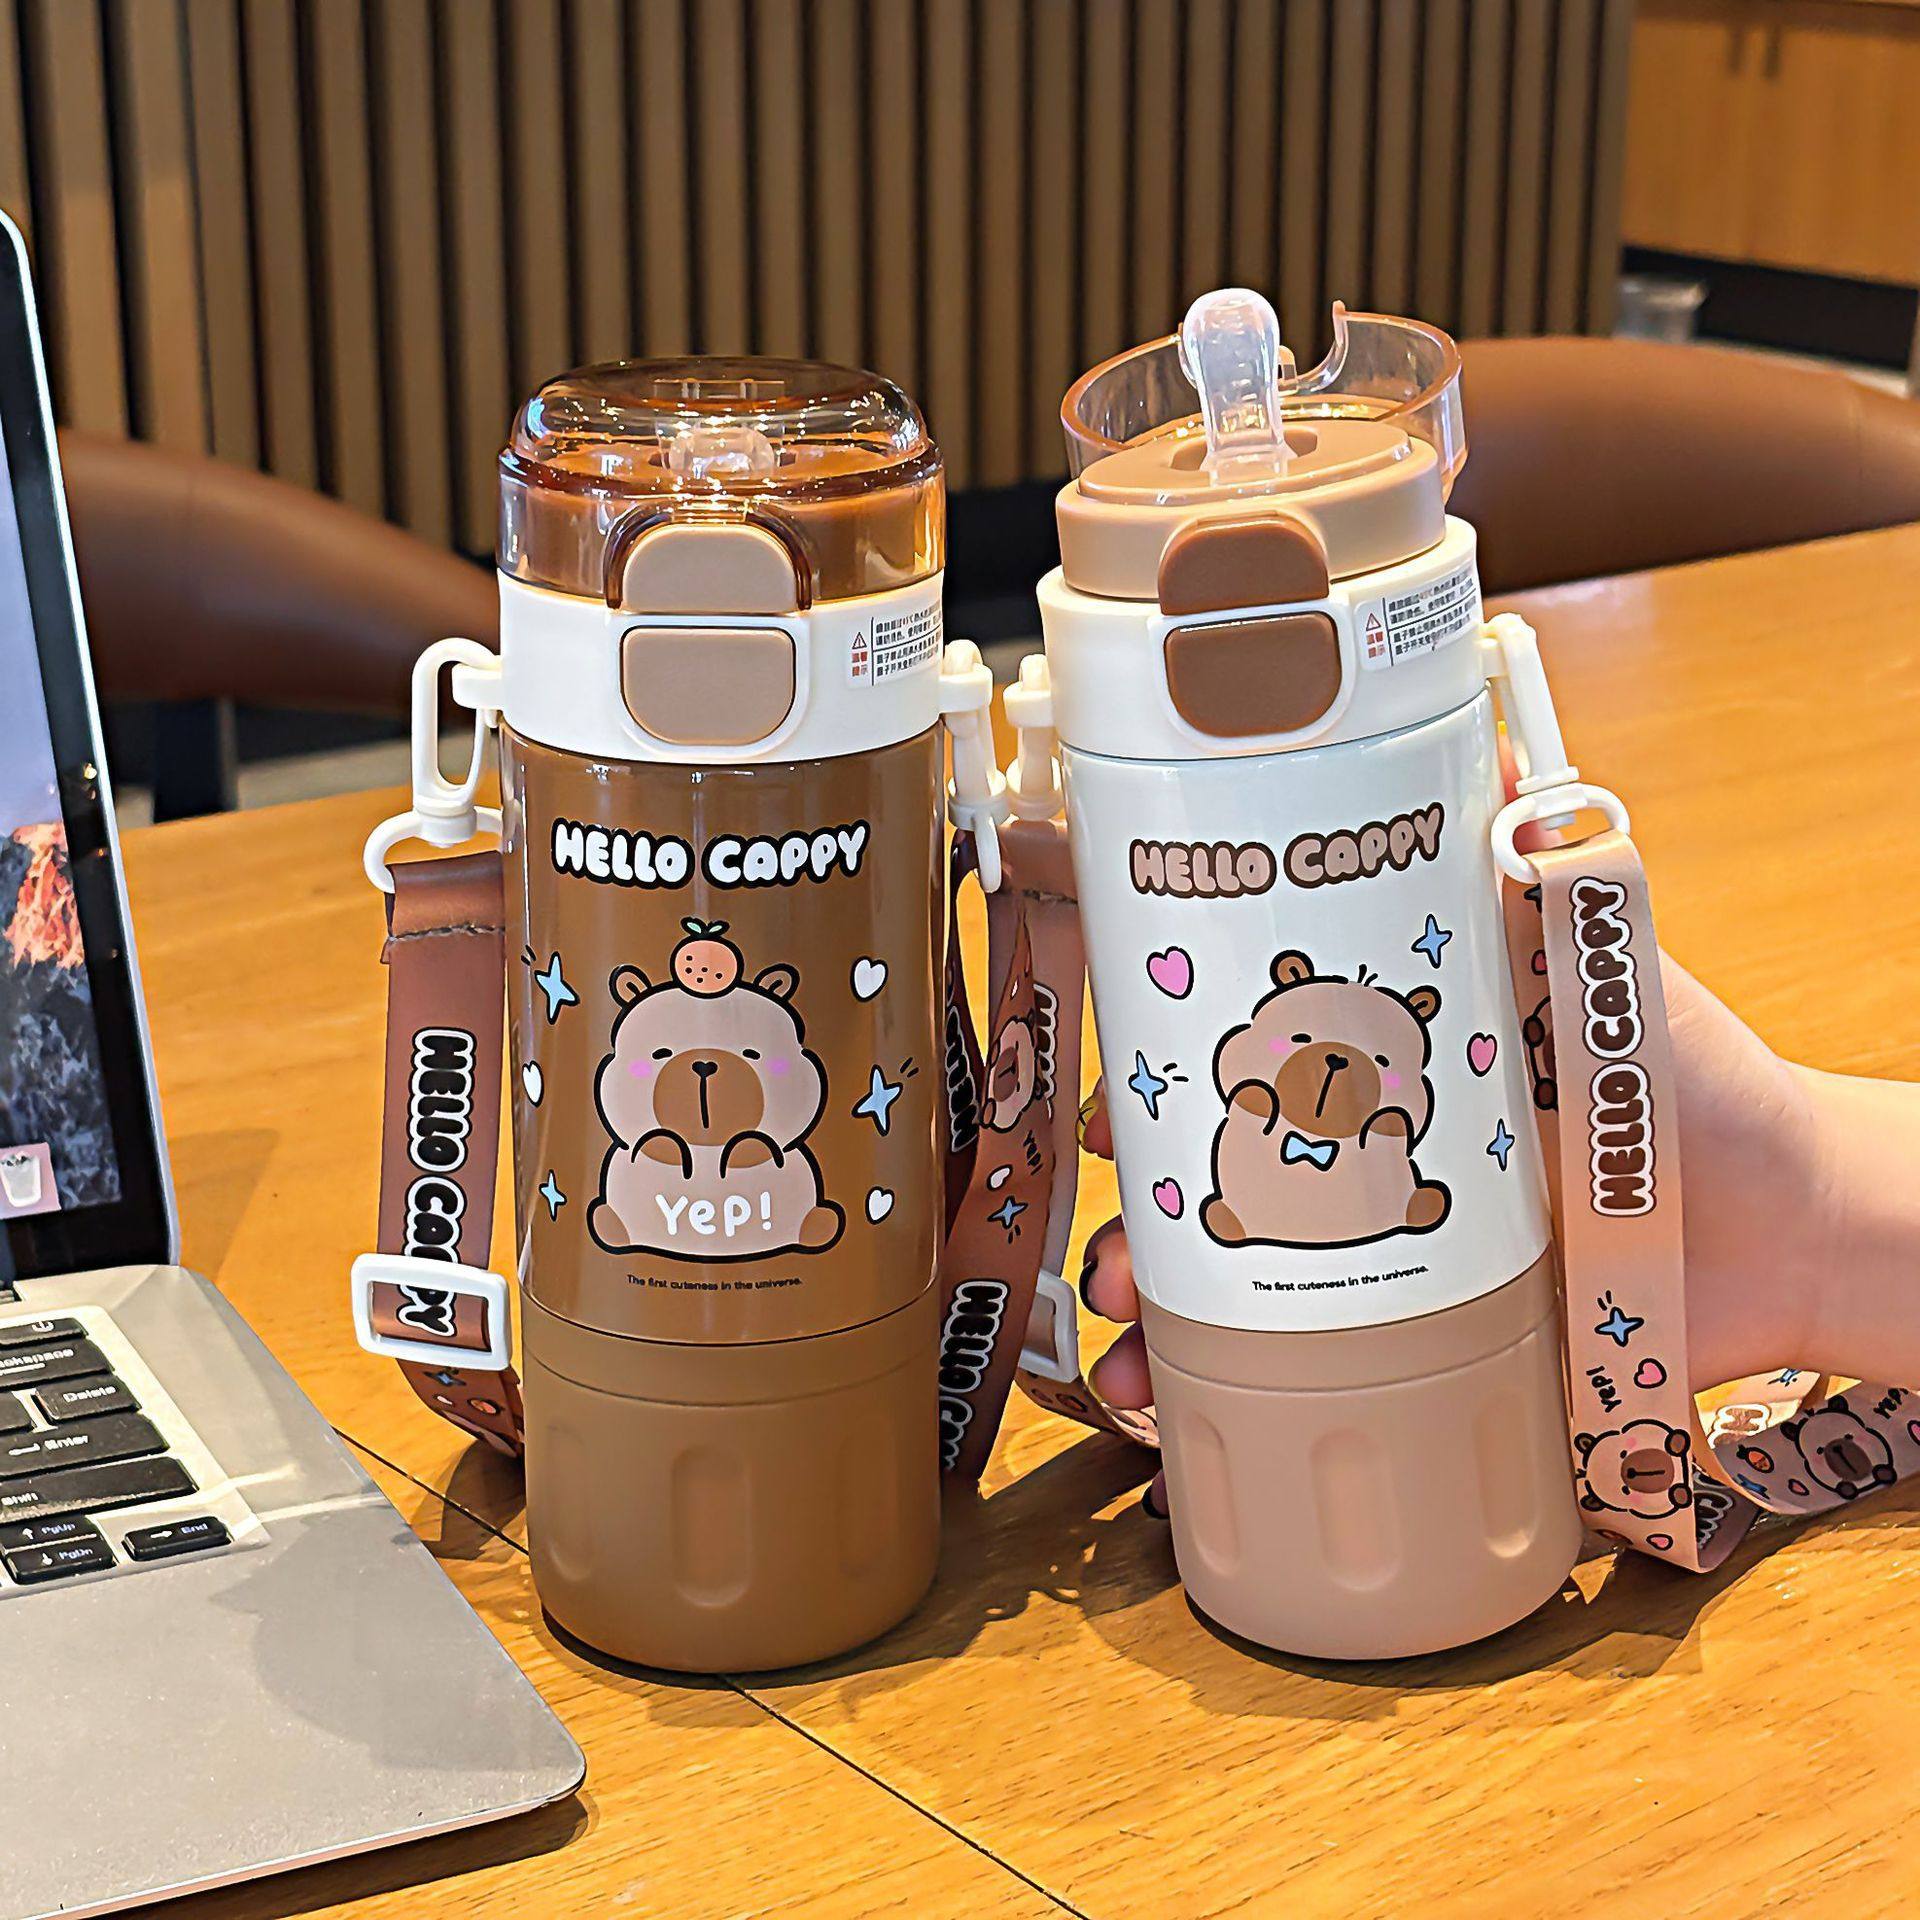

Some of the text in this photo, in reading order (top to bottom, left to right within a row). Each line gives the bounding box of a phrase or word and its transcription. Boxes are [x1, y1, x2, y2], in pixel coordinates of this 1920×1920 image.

[552, 818, 869, 890] HELLO CAPPY
[1131, 803, 1444, 897] HELLO CAPPY
[1570, 877, 1656, 1217] HELLO CAPPY
[408, 1027, 476, 1173] HELLO
[655, 1191, 772, 1237] Yep!
[627, 1274, 645, 1286] The
[648, 1277, 667, 1288] first
[670, 1281, 718, 1291] cuteness
[721, 1280, 731, 1291] in
[734, 1280, 752, 1290] the
[1252, 1265, 1429, 1291] The first cuteness in the universe.
[939, 1280, 1009, 1394] HELLO
[62, 1386, 116, 1403] Delete
[44, 1435, 89, 1450] Enter
[180, 1523, 209, 1534] End
